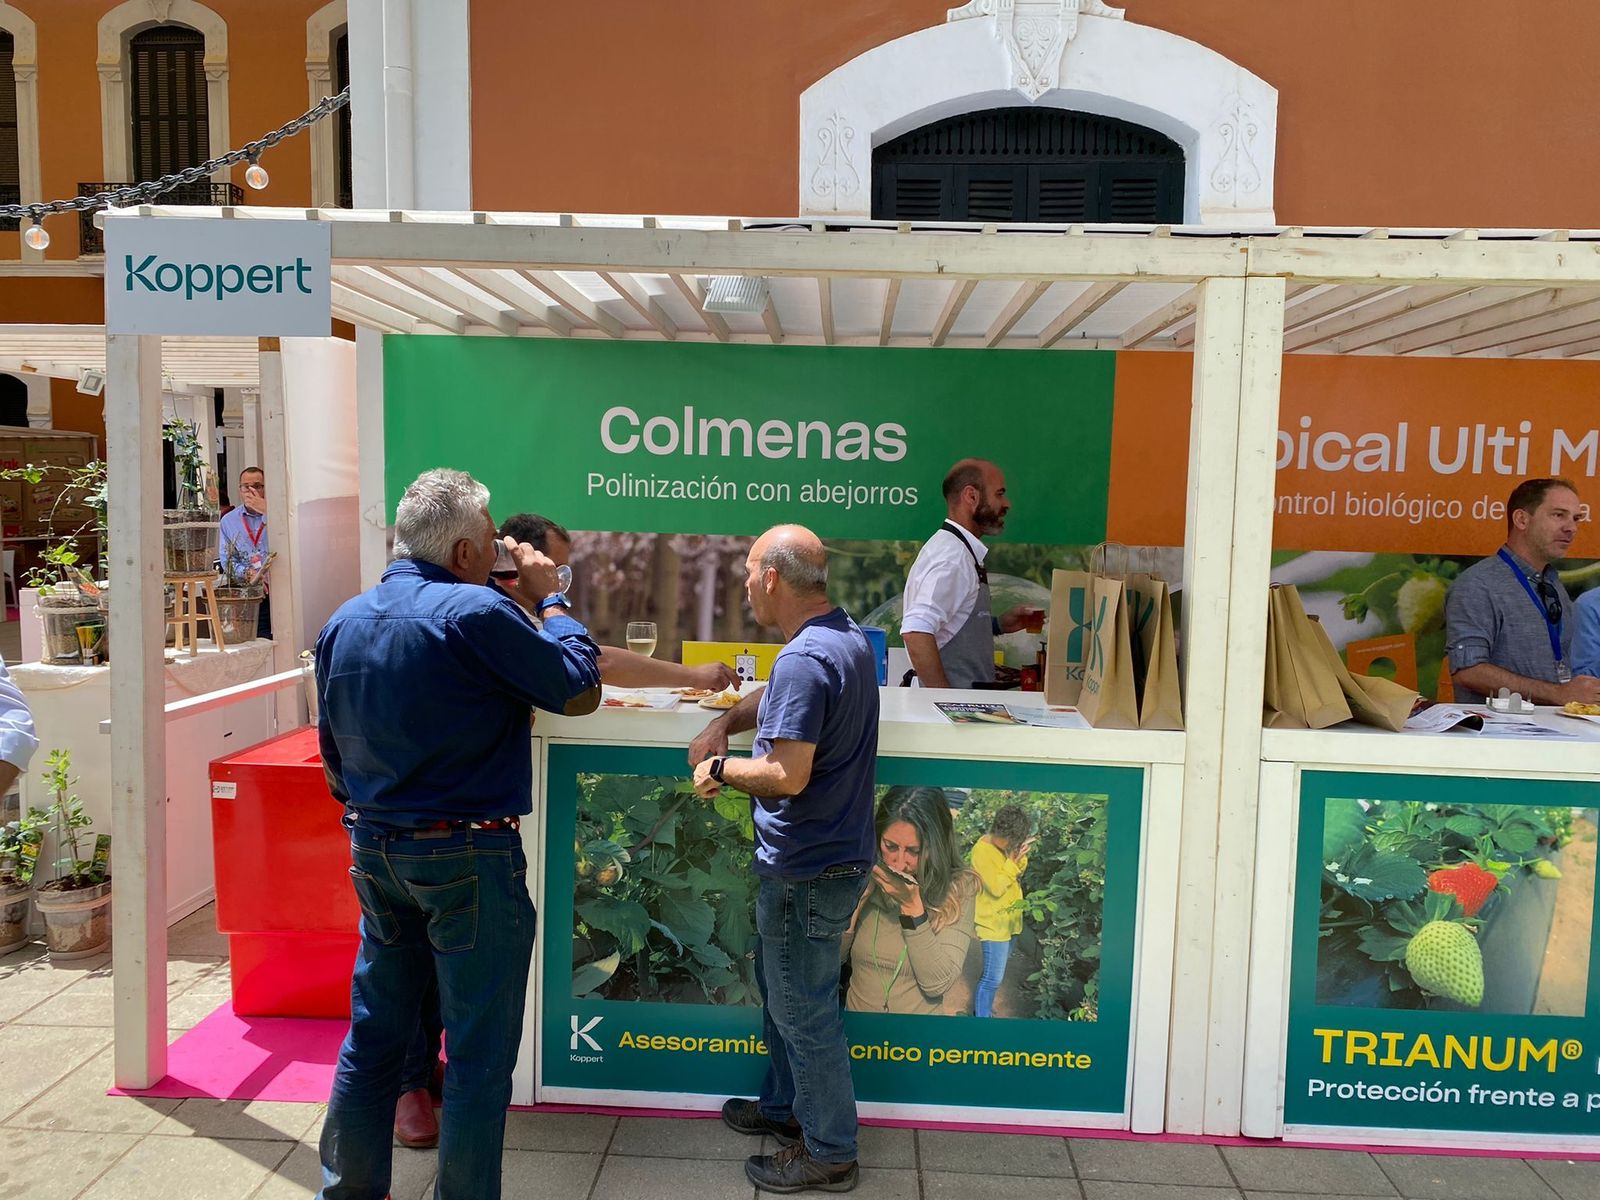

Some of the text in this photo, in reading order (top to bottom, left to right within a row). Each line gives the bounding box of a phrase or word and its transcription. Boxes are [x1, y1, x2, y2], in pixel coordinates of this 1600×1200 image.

[125, 254, 312, 301] Koppert
[600, 405, 907, 462] Colmenas
[1428, 420, 1532, 476] Ulti
[1550, 428, 1600, 477] M
[587, 472, 919, 510] Polinización con abejorros
[1273, 490, 1505, 525] ntrol biológico de
[570, 1015, 604, 1051] K
[618, 1031, 1092, 1070] Asesoramie cnico permanente
[570, 1054, 604, 1064] Koppert
[1308, 1078, 1460, 1104] Protección
[1467, 1084, 1556, 1108] frente
[1562, 1093, 1579, 1109] a
